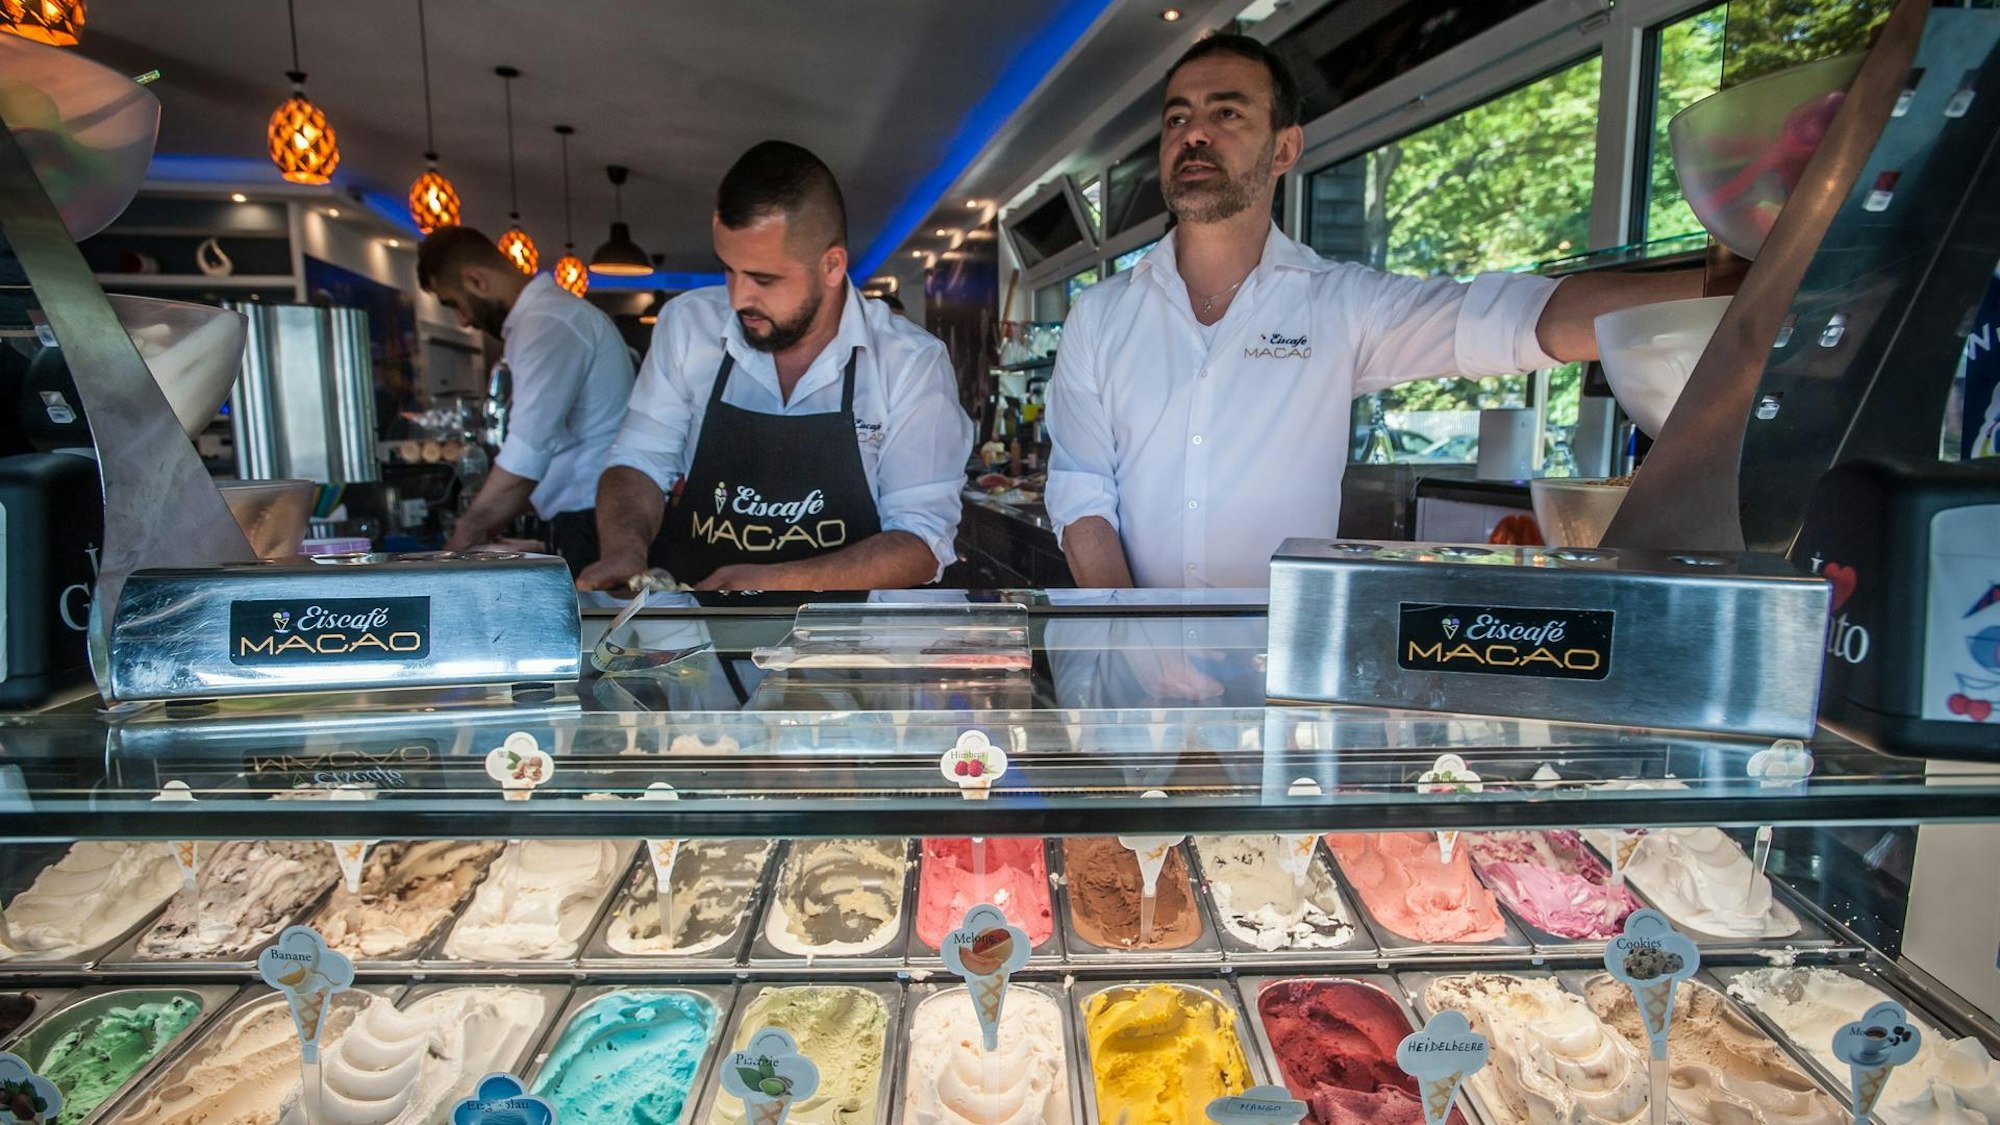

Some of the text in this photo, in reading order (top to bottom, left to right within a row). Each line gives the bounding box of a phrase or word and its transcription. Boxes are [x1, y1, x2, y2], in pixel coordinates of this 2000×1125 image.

[1244, 347, 1312, 359] MACAO
[732, 485, 825, 524] Eiscafé
[692, 511, 846, 551] MACAO
[297, 605, 390, 633] Eiscafé
[1465, 614, 1567, 646] Eiscafé
[240, 631, 421, 656] MACAO
[1408, 640, 1600, 670] MACAO
[954, 932, 995, 945] Melone
[1616, 937, 1662, 950] Cookies
[270, 949, 312, 962] Banane
[1240, 1102, 1282, 1112] MANGO
